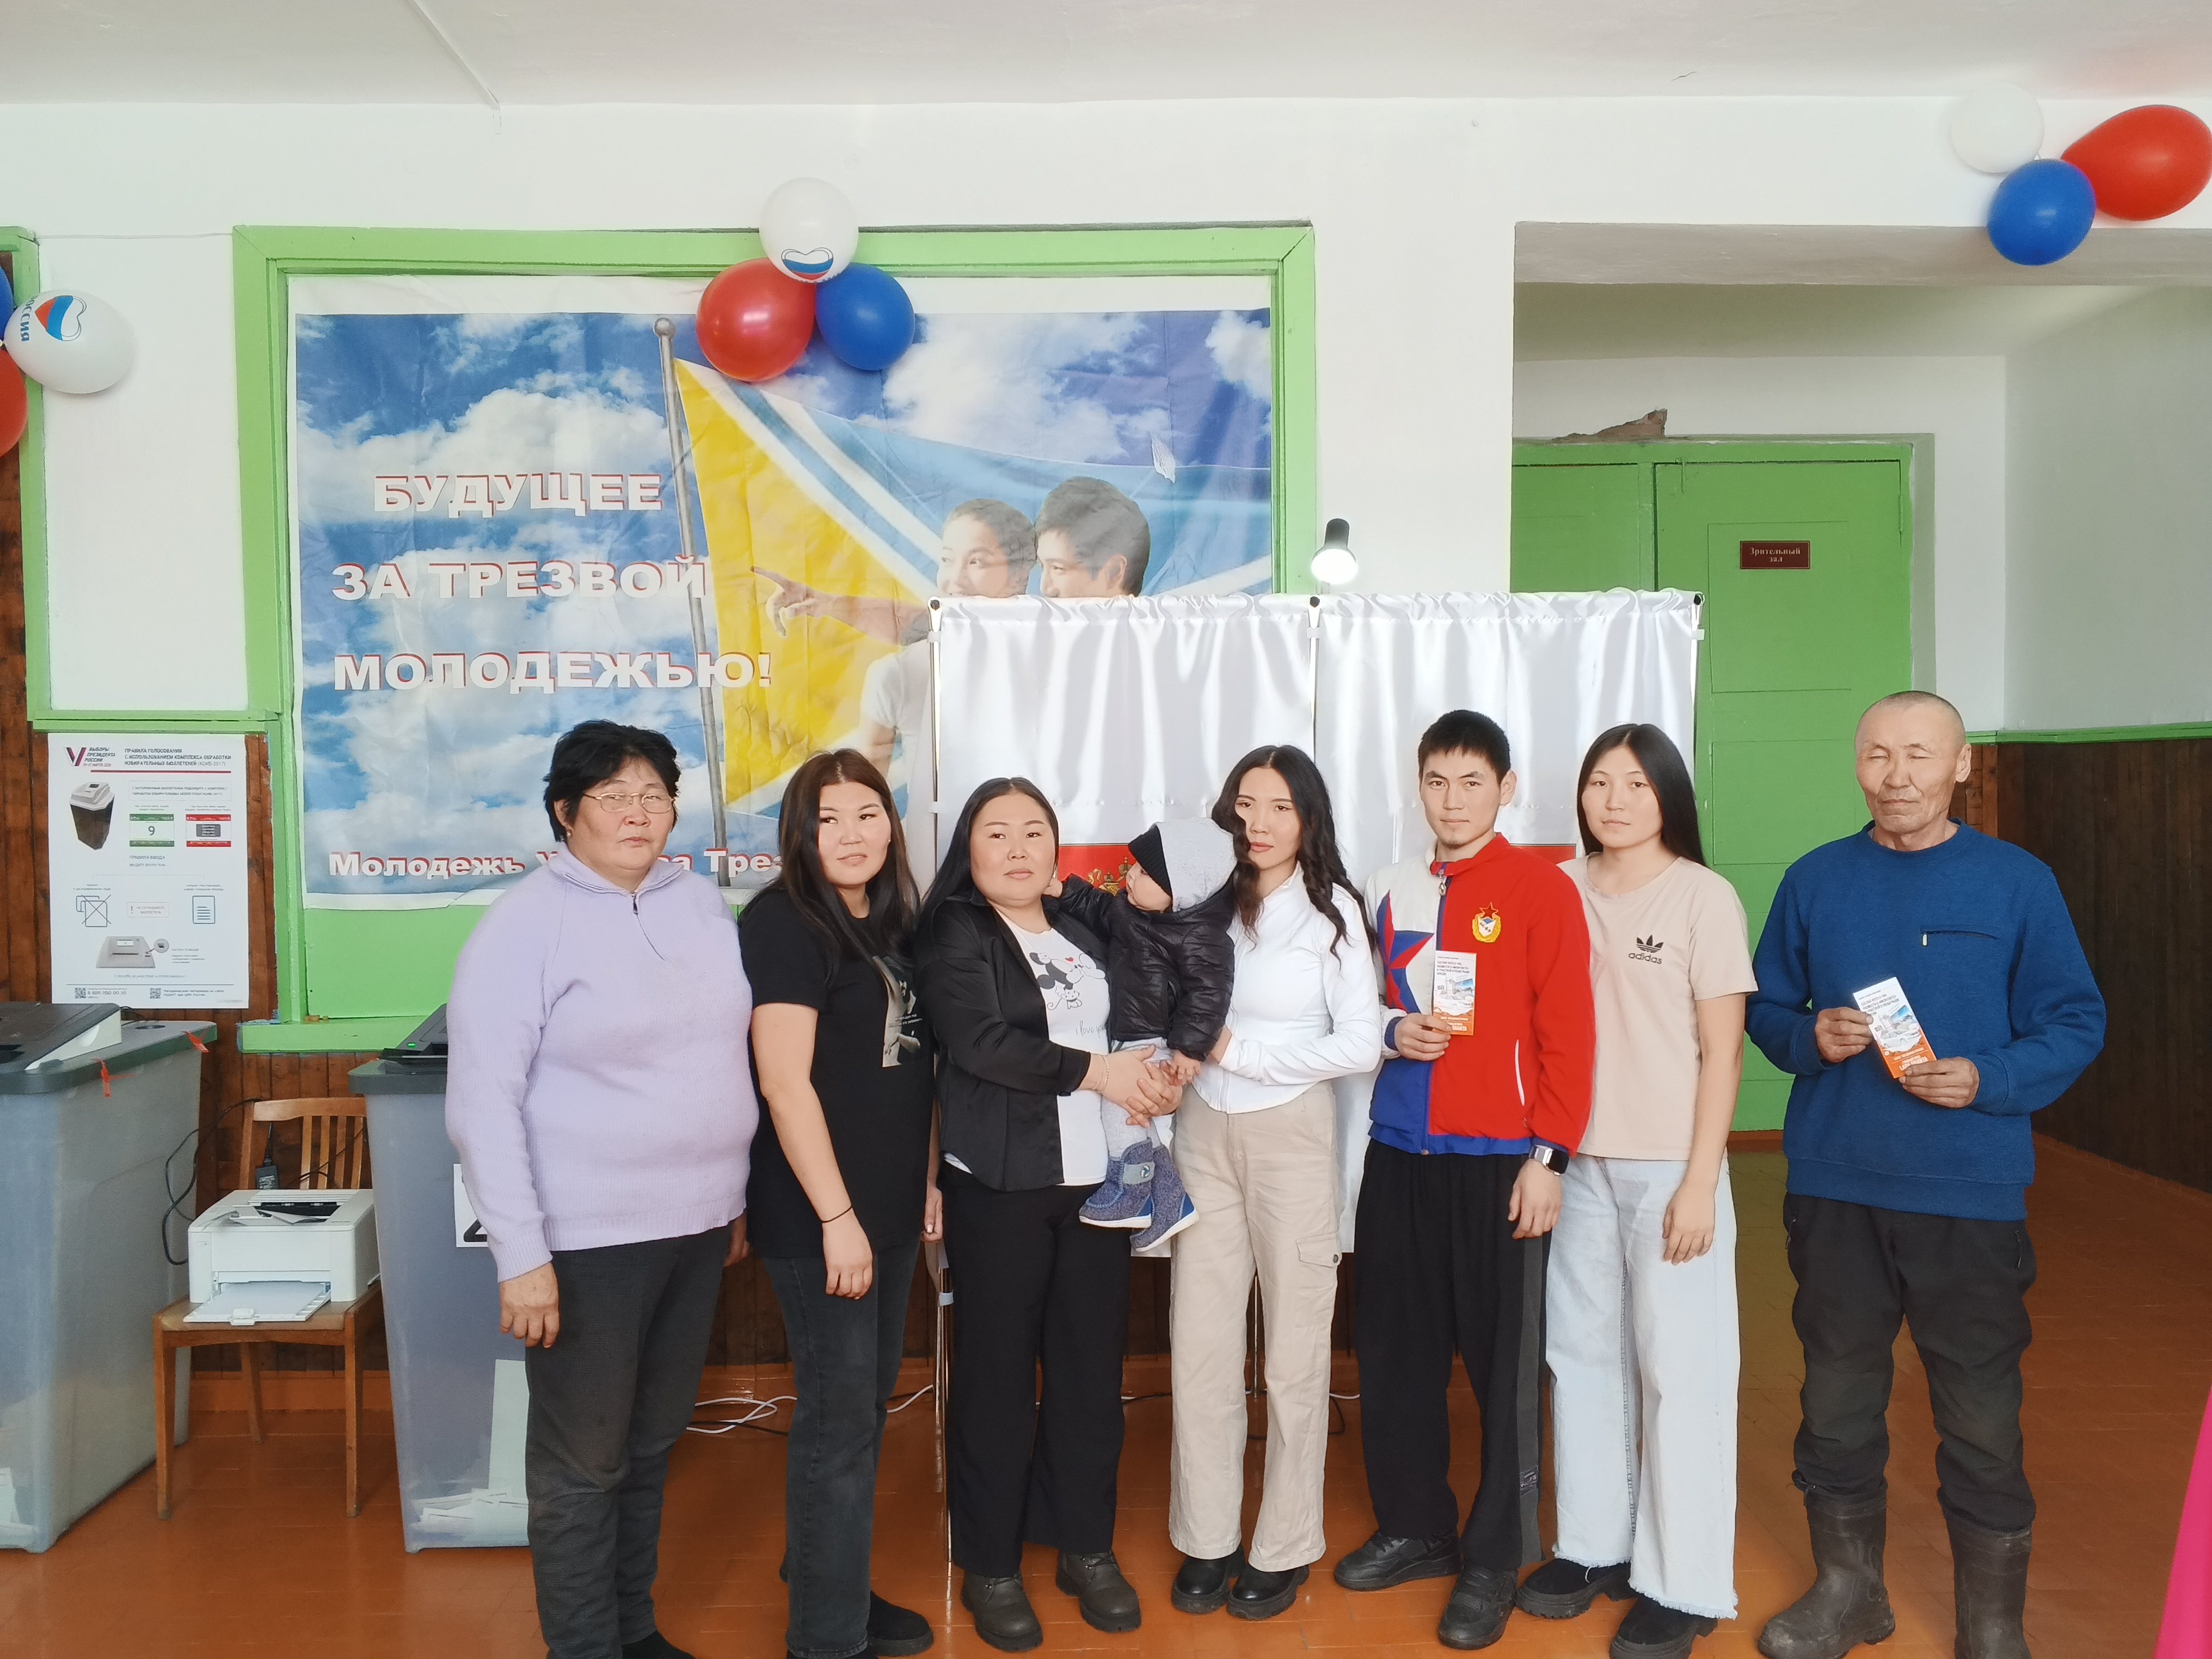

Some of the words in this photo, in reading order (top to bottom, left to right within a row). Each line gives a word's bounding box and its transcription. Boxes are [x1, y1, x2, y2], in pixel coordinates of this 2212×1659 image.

[373, 472, 663, 518] БУДУЩЕЕ
[1749, 547, 1801, 556] Зрительный
[331, 562, 411, 600] ЗА
[428, 554, 706, 599] ТРЕЗВОЙ
[334, 651, 772, 694] МОЛОДЕЖЬЮ!
[148, 825, 156, 836] 9
[329, 851, 525, 880] Молодежь
[1628, 953, 1662, 964] adidas
